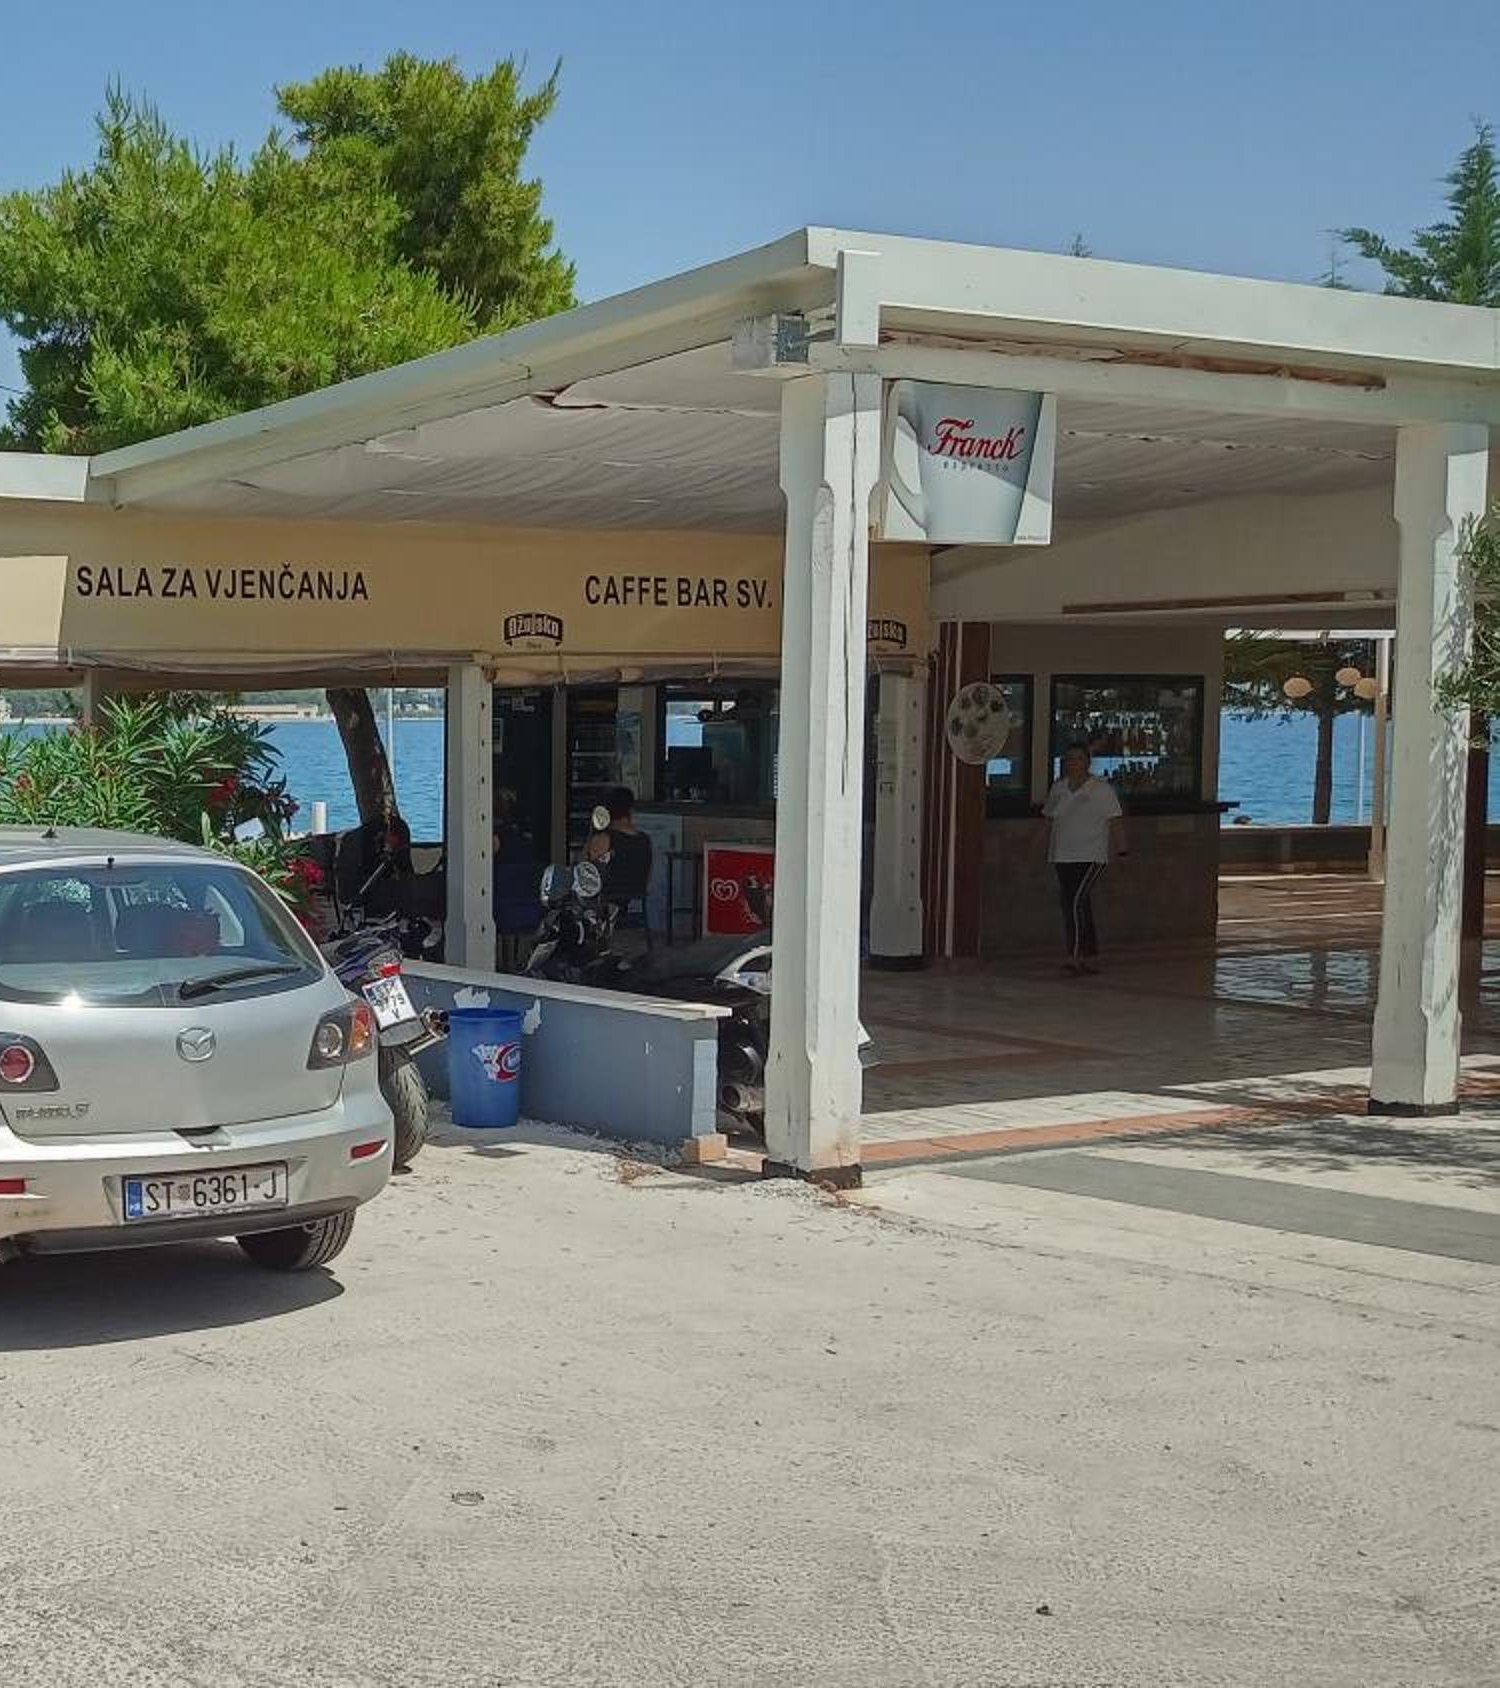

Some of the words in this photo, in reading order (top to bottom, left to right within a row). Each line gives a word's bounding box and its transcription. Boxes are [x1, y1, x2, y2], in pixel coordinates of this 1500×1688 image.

[928, 416, 1026, 461] Franck
[76, 566, 153, 597] SALA
[161, 568, 198, 598] ZA
[205, 562, 369, 600] VJENČANJA
[585, 575, 669, 606] CAFFE
[676, 577, 728, 607] BAR
[736, 579, 773, 608] SV.
[508, 612, 560, 638] Ožujsko
[145, 1181, 175, 1211] ST
[193, 1170, 277, 1207] 6361-J
